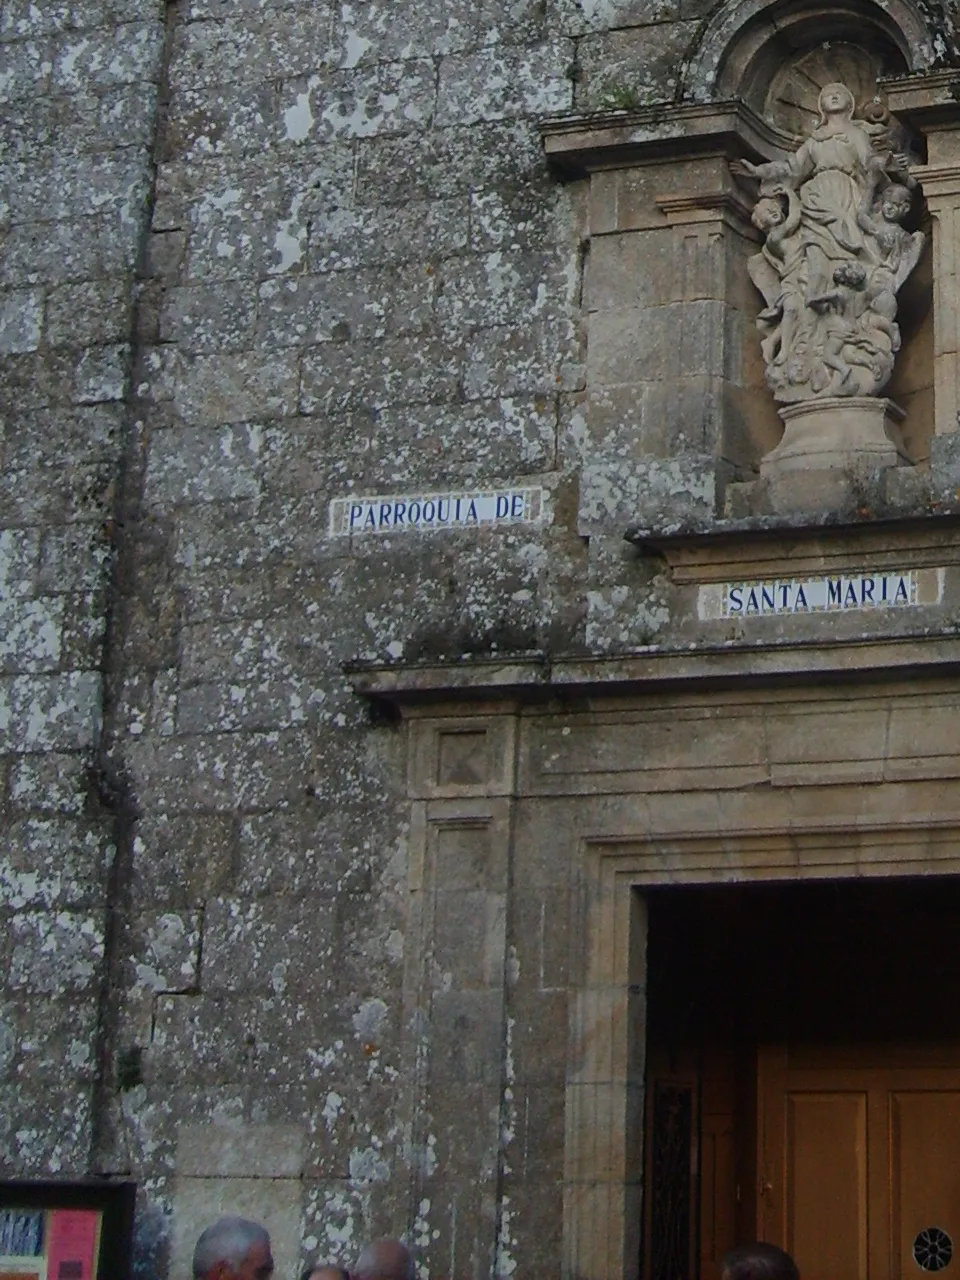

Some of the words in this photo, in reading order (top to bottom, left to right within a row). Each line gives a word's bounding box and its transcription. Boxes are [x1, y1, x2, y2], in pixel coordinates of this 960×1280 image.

[350, 498, 478, 528] PARROQUIA
[495, 495, 524, 519] DE
[729, 584, 808, 611] SANTA
[827, 576, 909, 605] MARIA
